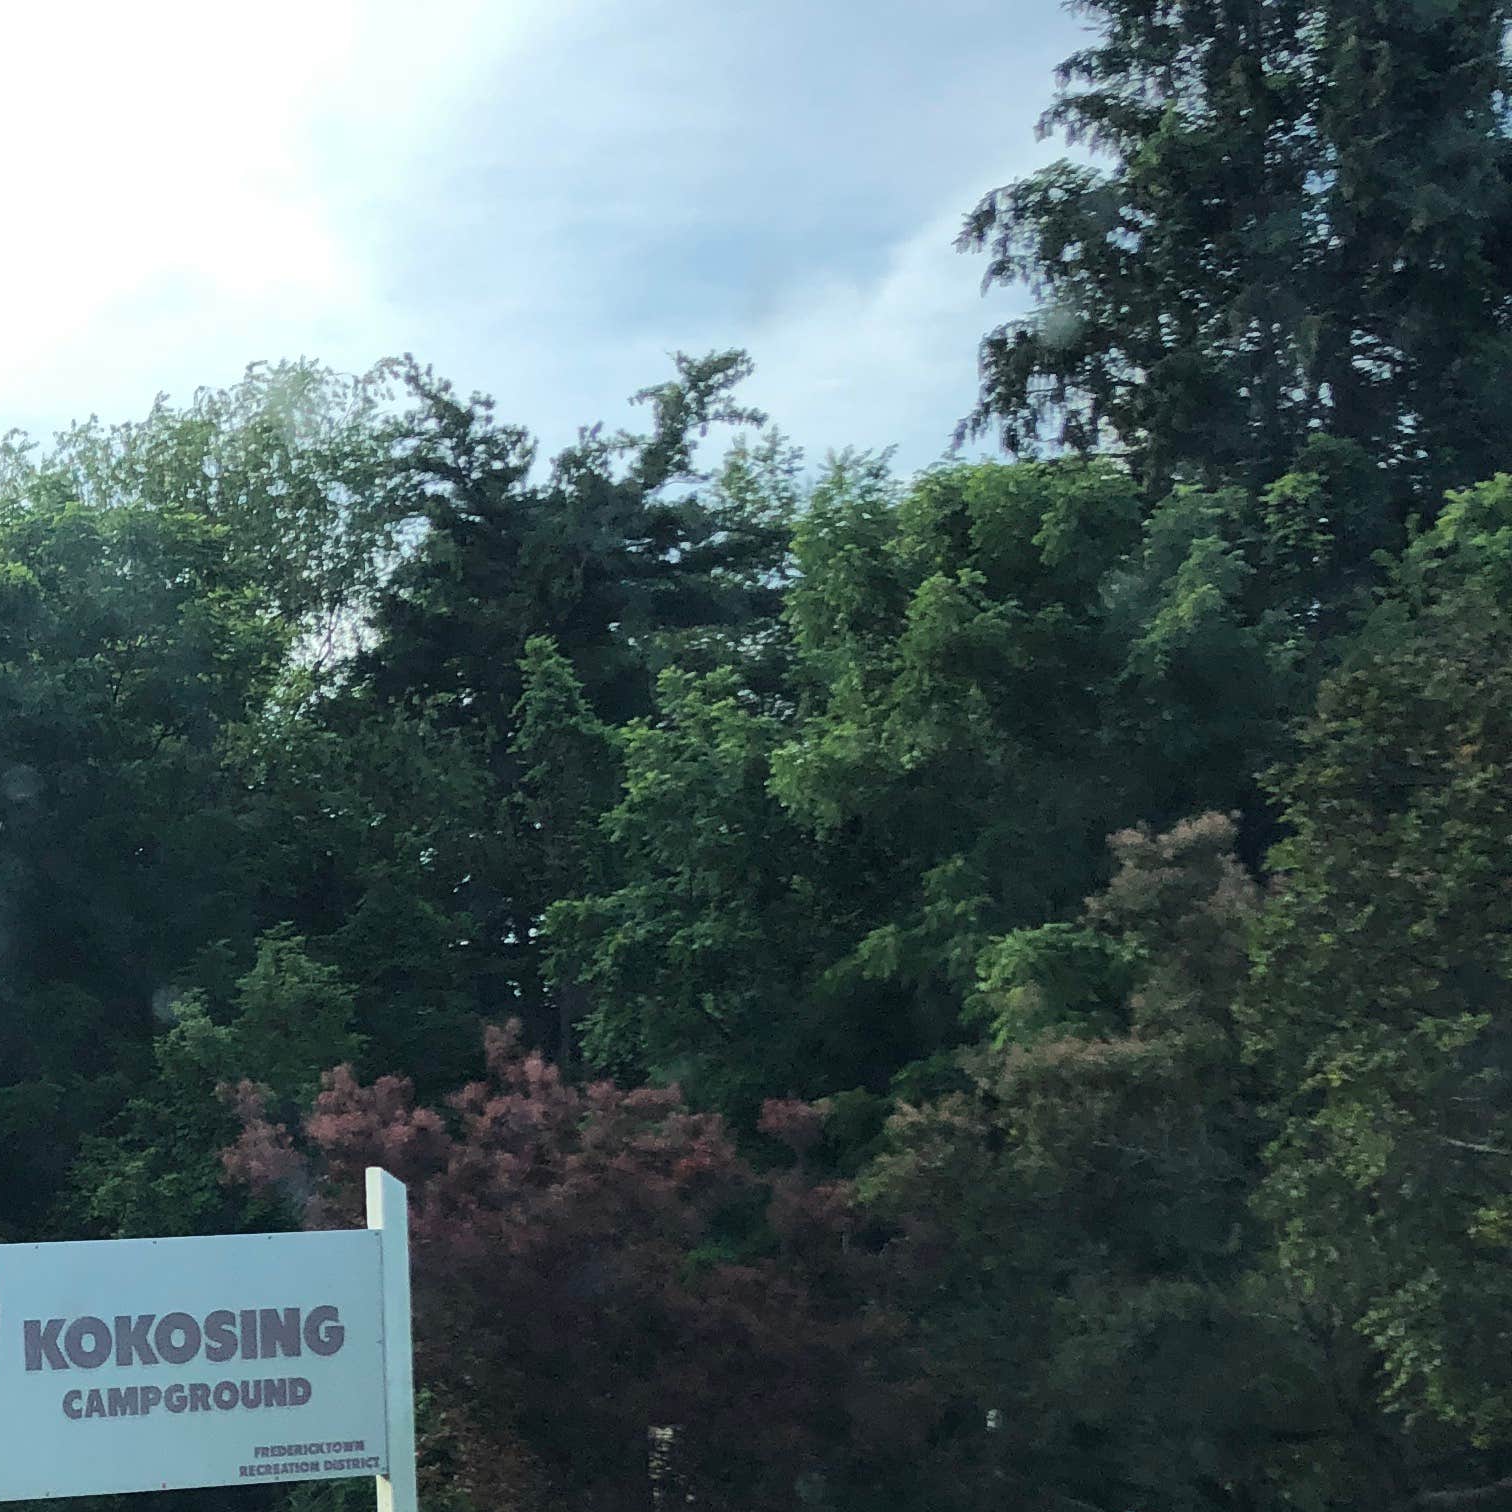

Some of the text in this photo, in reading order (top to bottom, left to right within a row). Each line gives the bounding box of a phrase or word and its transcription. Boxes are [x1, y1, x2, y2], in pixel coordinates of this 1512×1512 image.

[23, 1305, 345, 1371] KOKOSING
[62, 1377, 312, 1420] CAMPGROUND
[254, 1440, 365, 1458] FREDERICKTOWN
[239, 1456, 380, 1477] RECREATION DISTRICT
